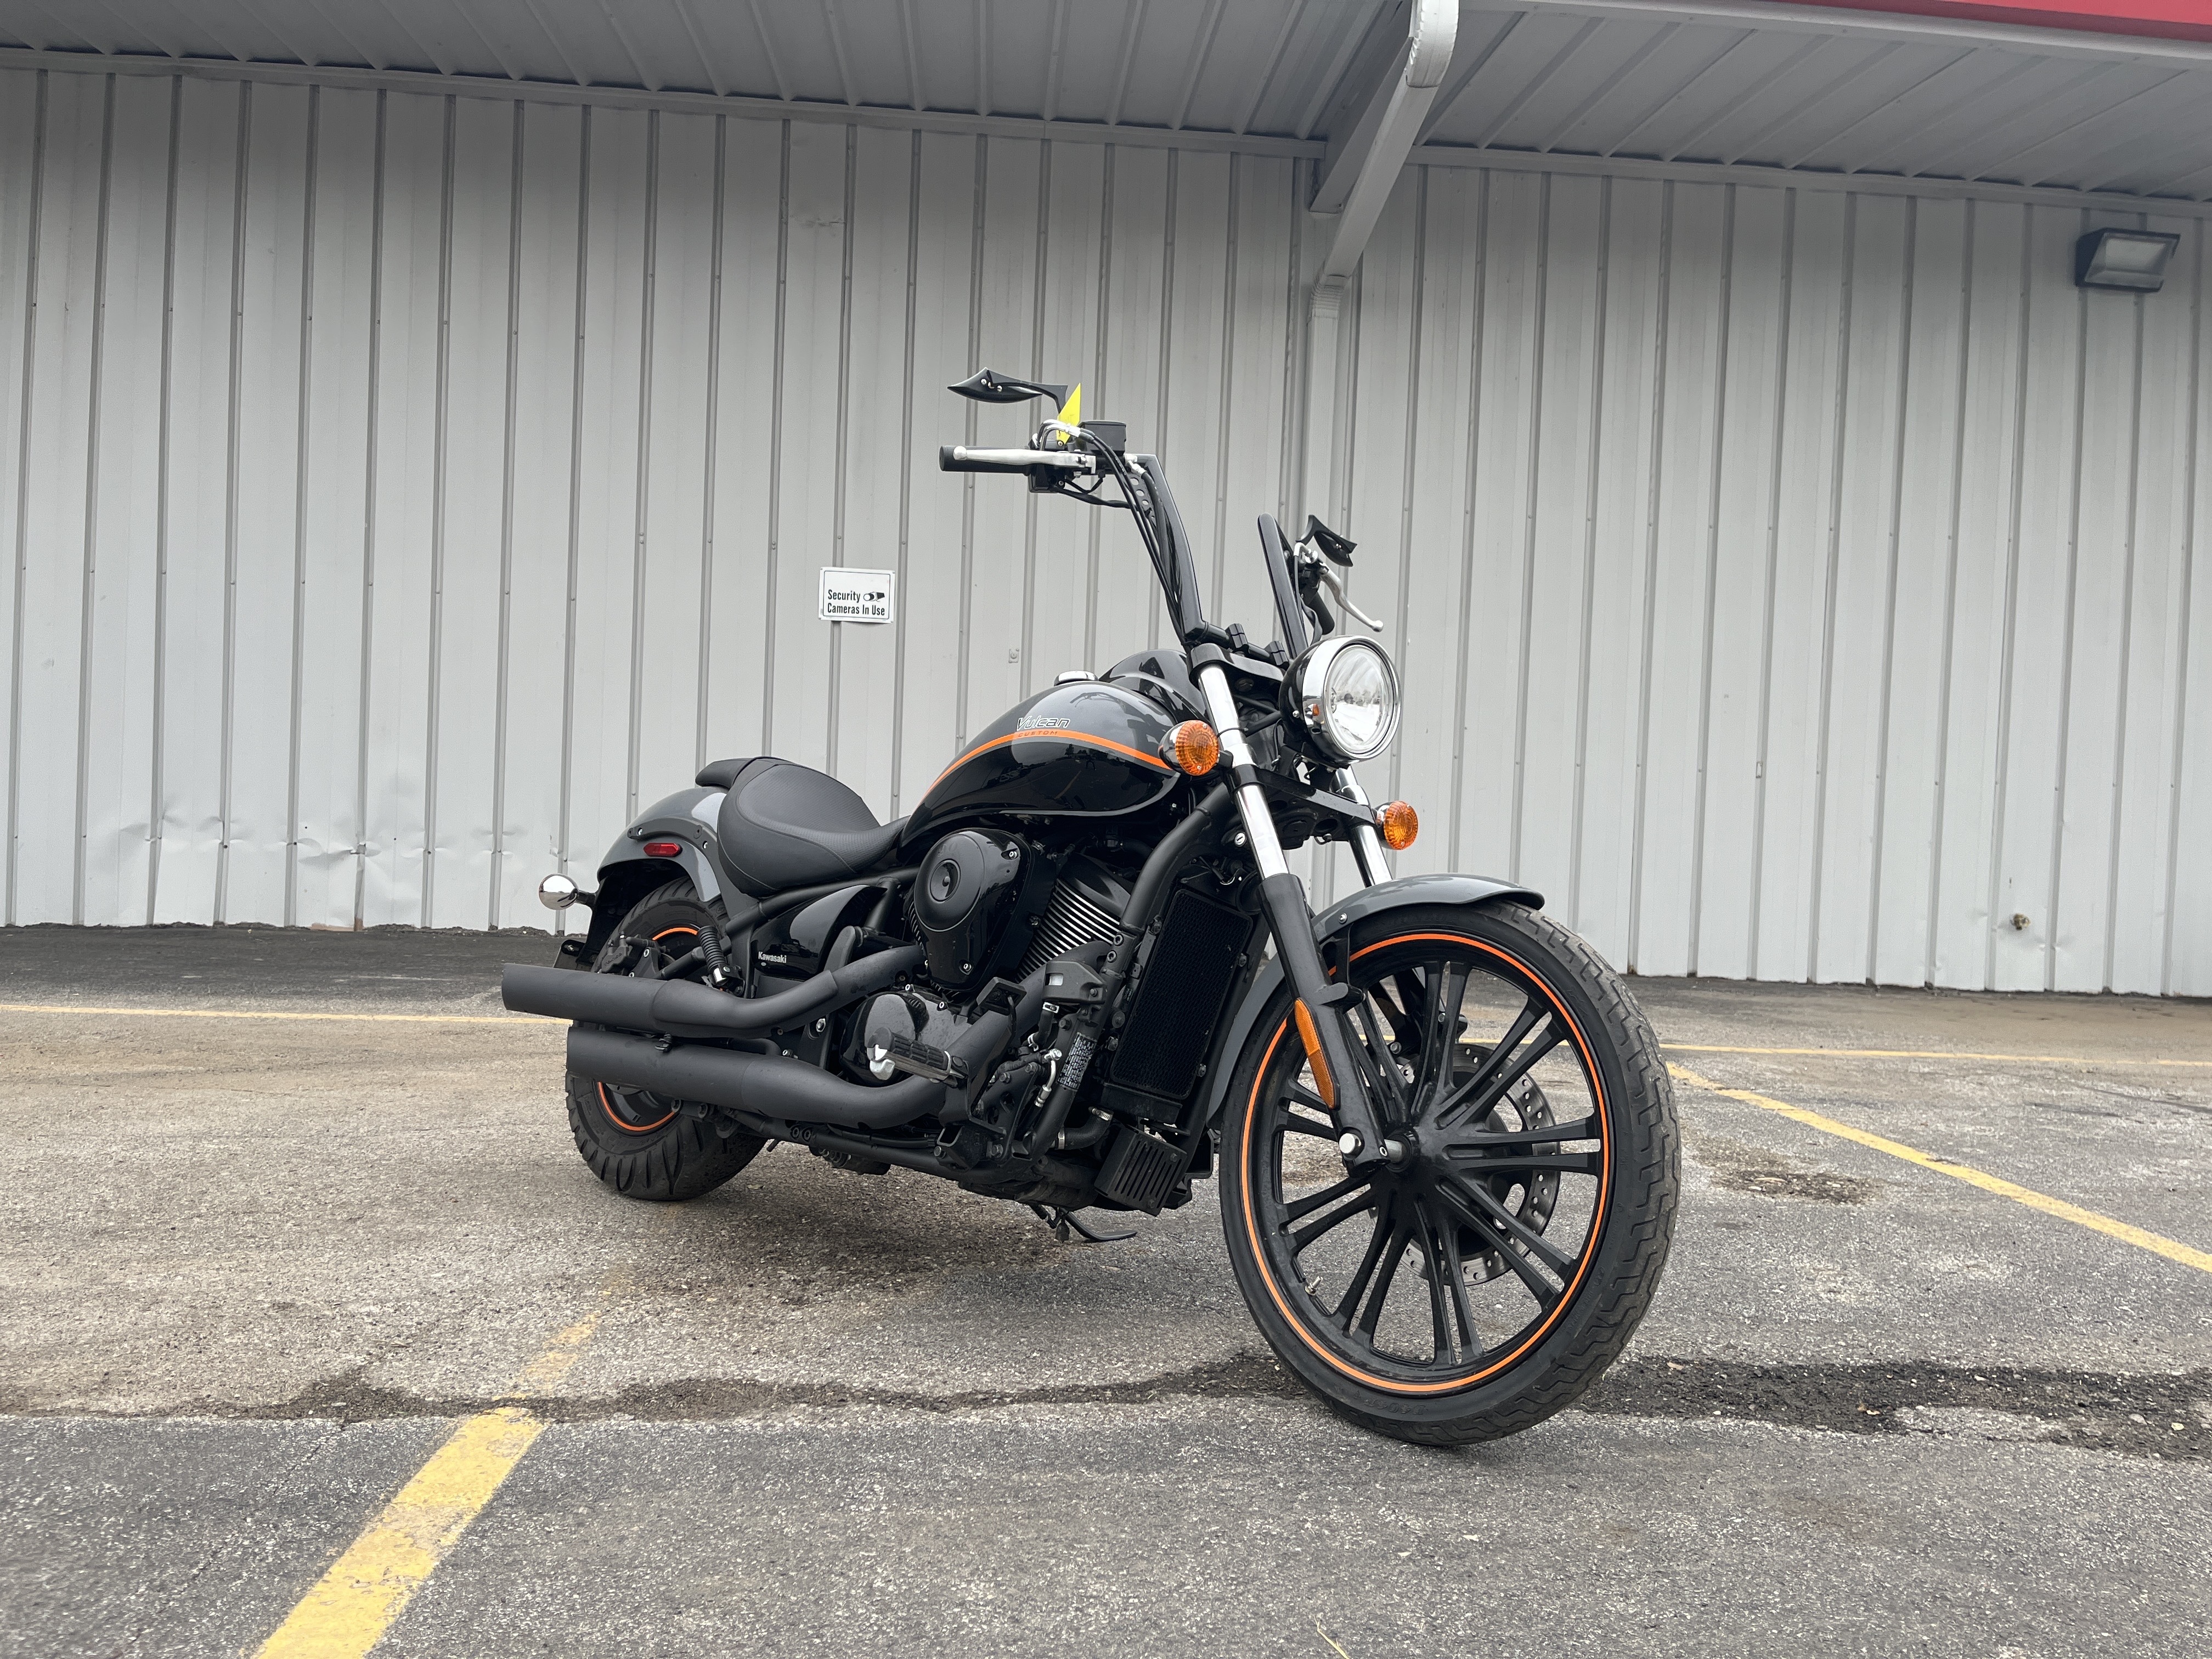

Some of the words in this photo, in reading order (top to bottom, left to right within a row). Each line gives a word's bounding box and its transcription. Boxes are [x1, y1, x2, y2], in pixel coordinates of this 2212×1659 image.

[828, 589, 860, 603] Security
[827, 602, 860, 614] Cameras
[862, 605, 869, 614] In
[872, 605, 885, 616] Use
[1017, 715, 1070, 731] Vulcan
[758, 951, 787, 963] Kawasaki
